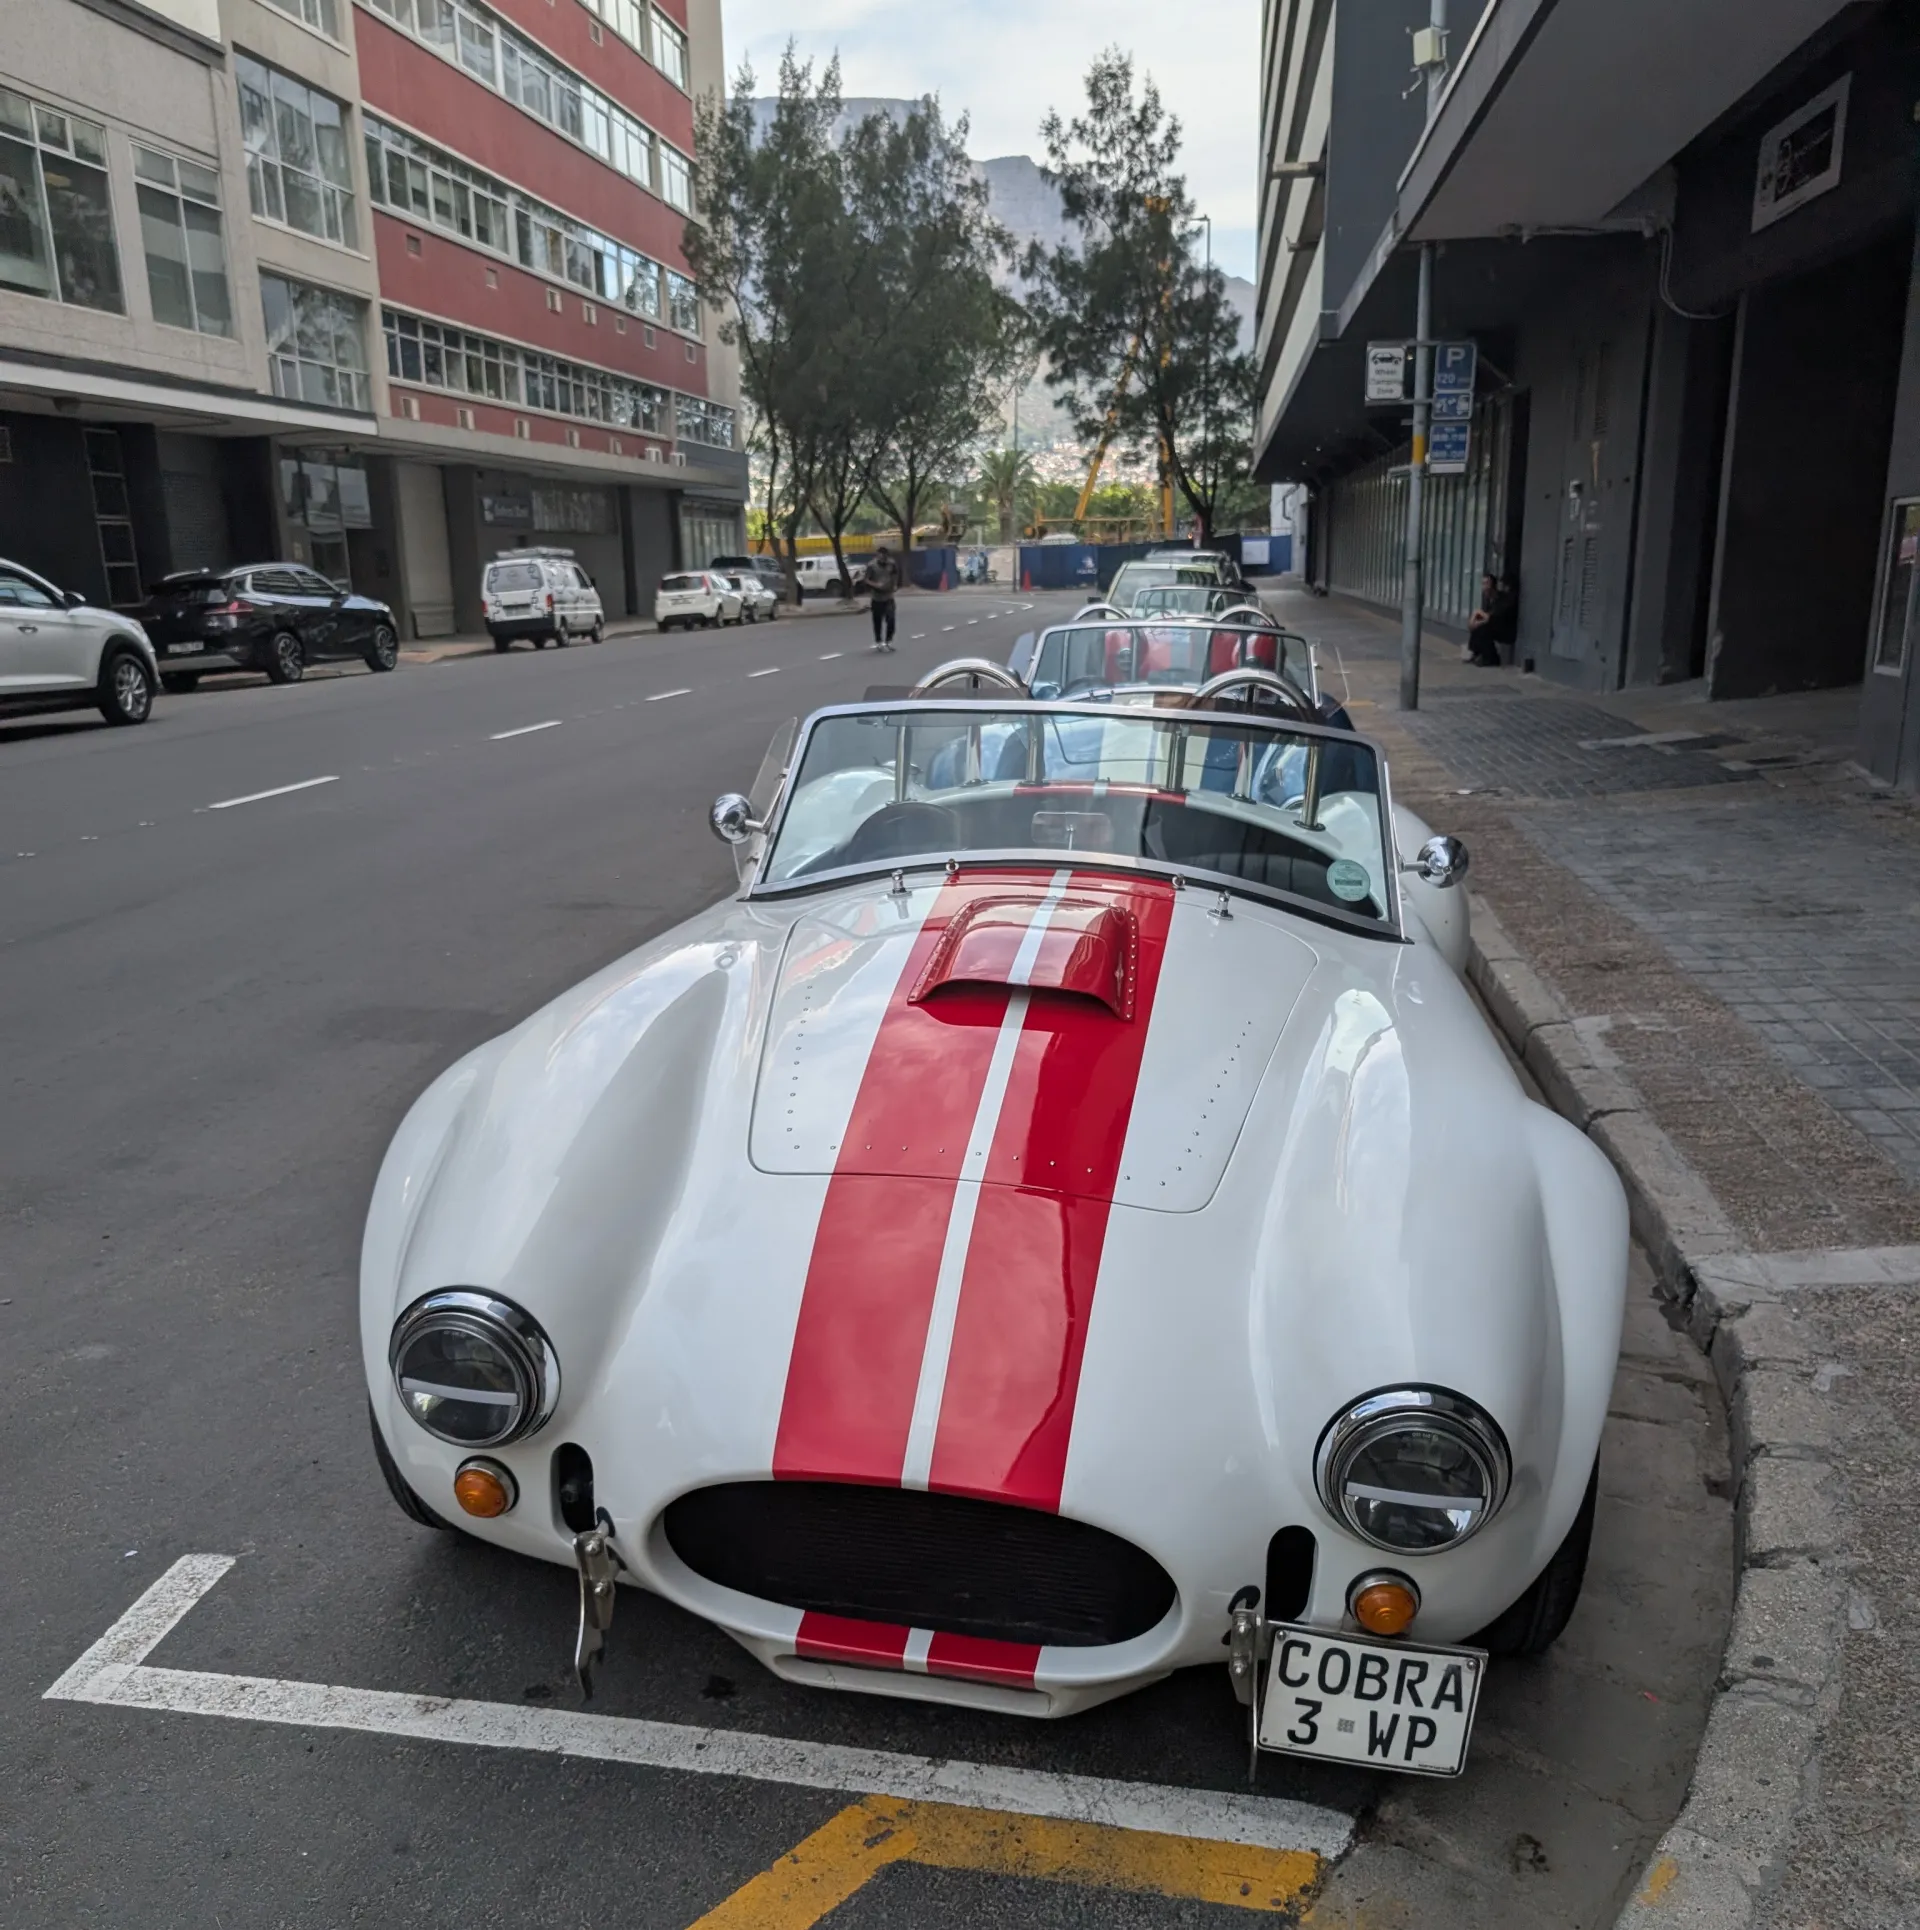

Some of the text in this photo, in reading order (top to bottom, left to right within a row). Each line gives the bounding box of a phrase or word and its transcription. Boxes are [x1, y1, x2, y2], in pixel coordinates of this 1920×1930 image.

[1446, 348, 1466, 368] P
[1278, 1639, 1464, 1712] COBRA
[1286, 1697, 1437, 1761] 3 WP
